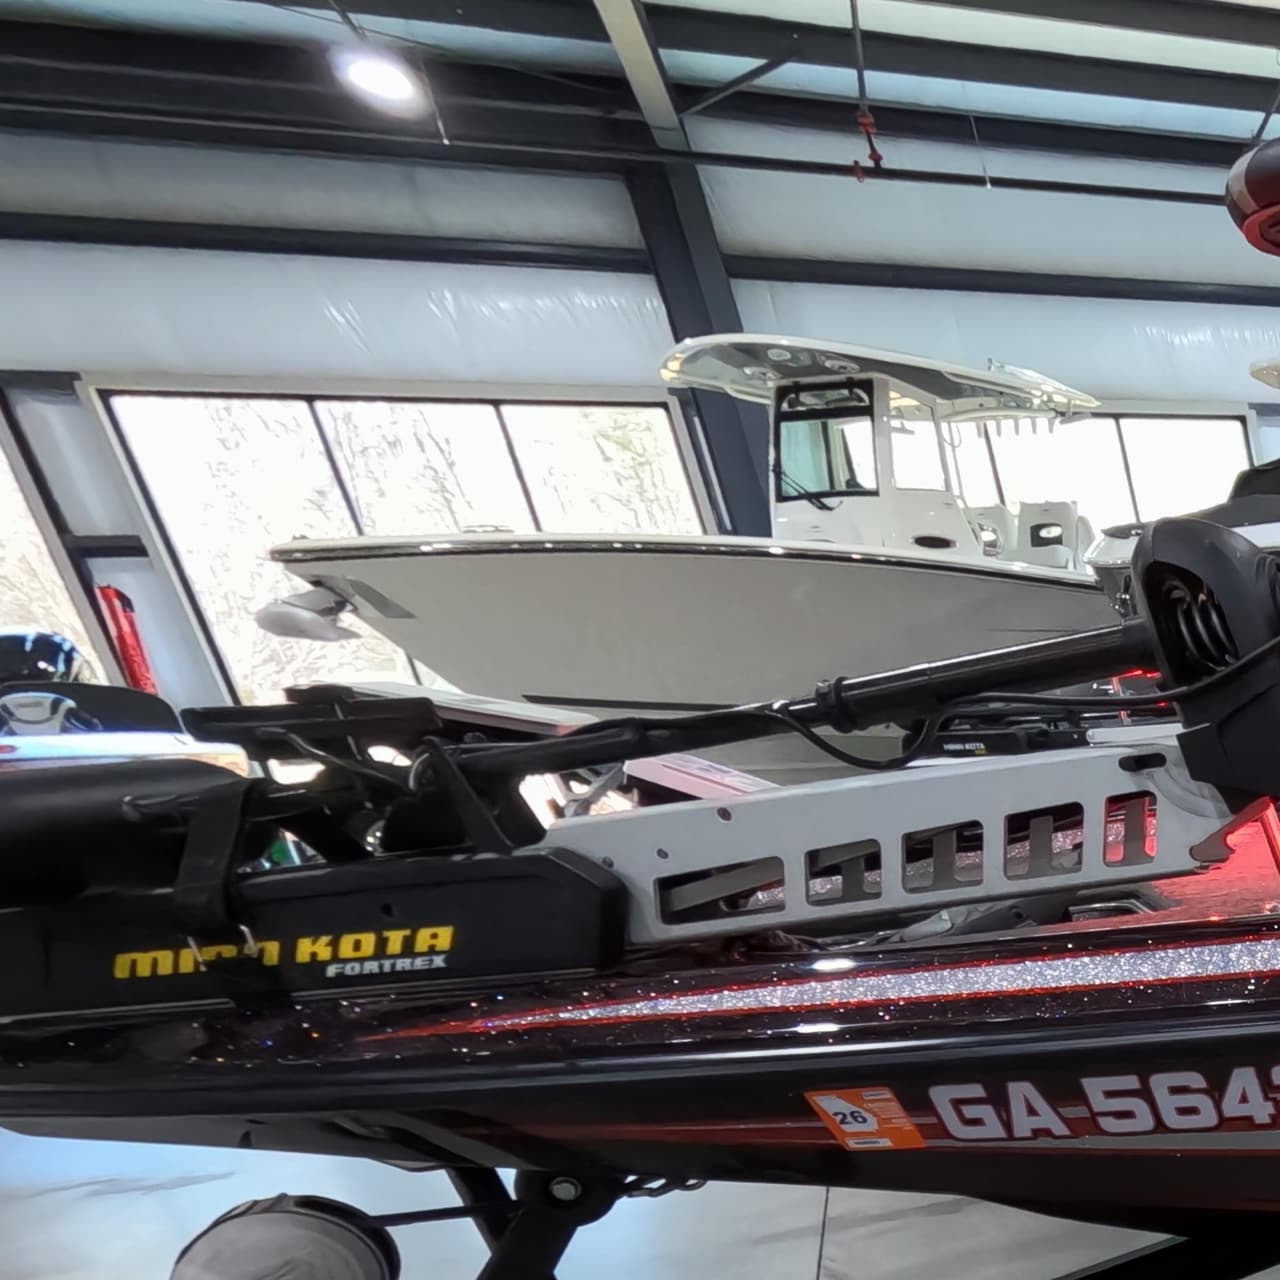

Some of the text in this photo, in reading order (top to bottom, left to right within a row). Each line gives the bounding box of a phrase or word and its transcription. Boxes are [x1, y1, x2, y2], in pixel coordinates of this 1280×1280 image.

[296, 926, 455, 963] KOTA
[326, 954, 448, 977] FORTREX
[832, 1110, 868, 1125] 26
[927, 1081, 1074, 1141] GA
